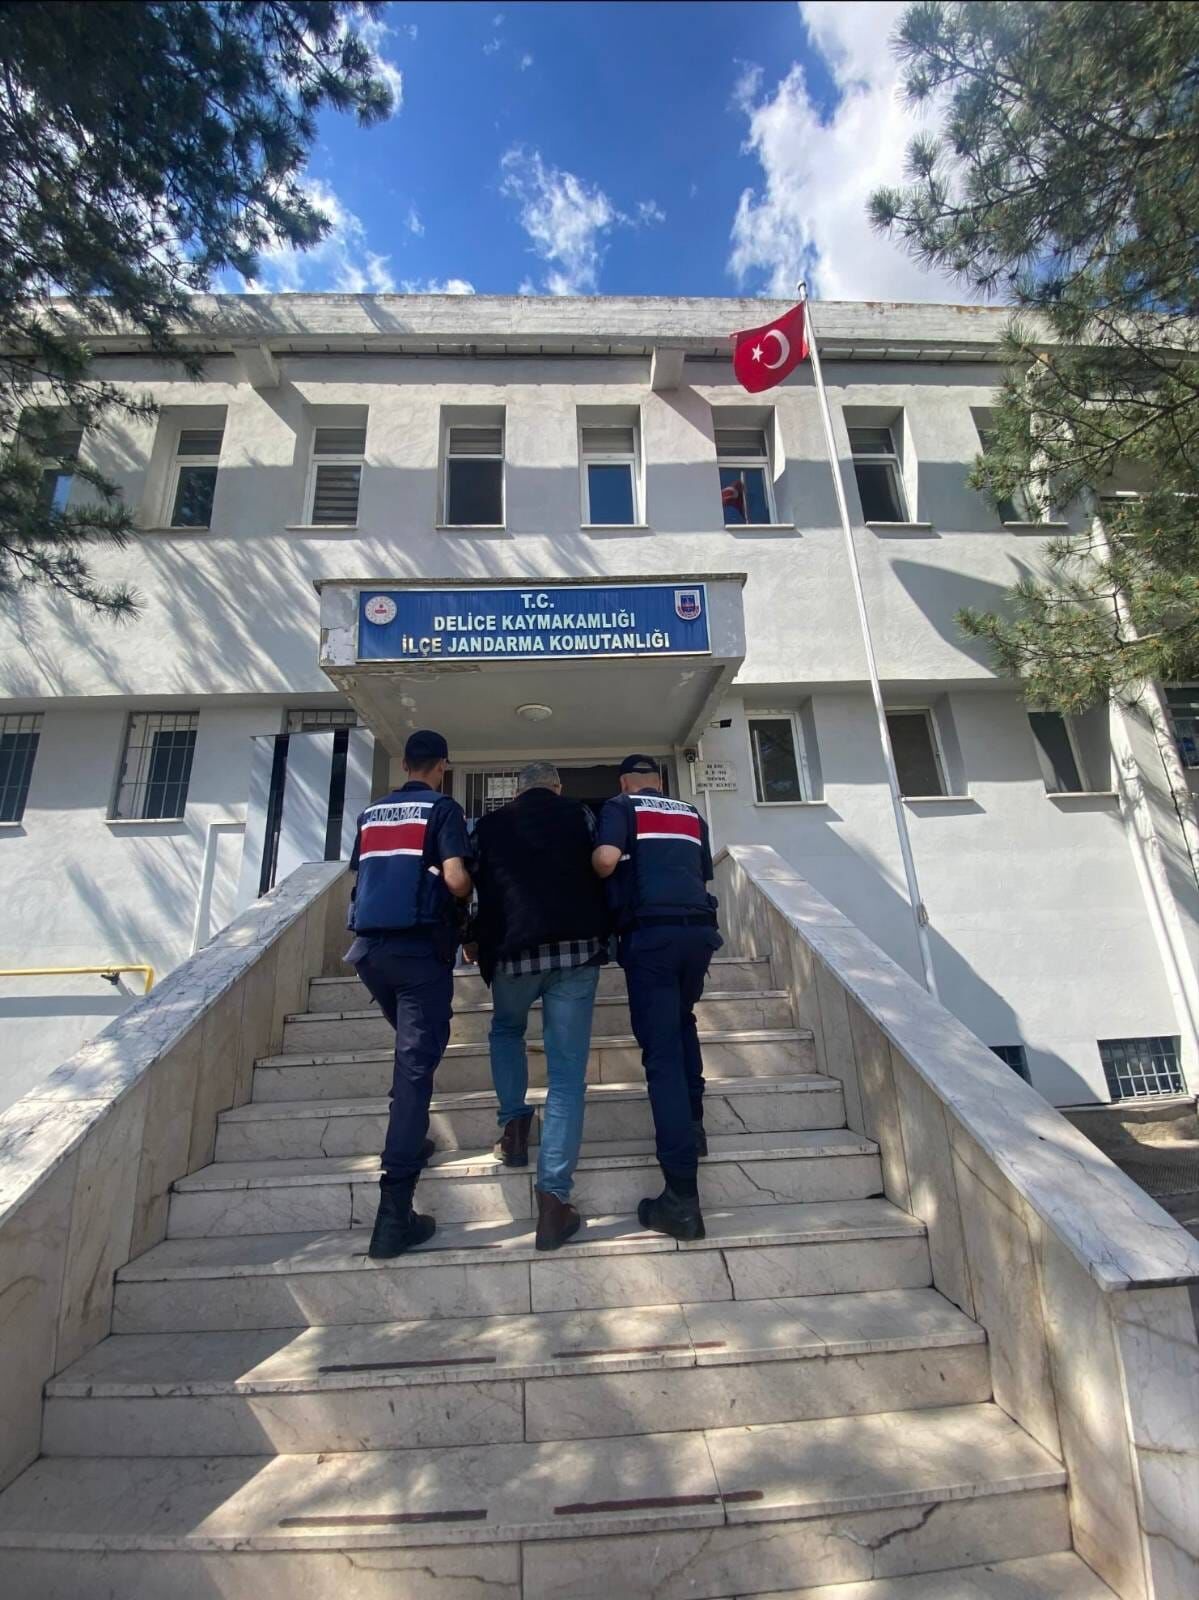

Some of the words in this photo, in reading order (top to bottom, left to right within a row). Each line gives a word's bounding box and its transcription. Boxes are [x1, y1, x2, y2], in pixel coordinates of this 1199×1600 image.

[520, 594, 554, 608] T.C.
[434, 612, 496, 631] DELİCE
[502, 609, 635, 630] KAYMAKAMLIĞI
[402, 634, 441, 656] İLÇE
[447, 635, 544, 653] JANDARMA
[549, 629, 671, 651] KOMUTANLIĞI
[368, 806, 421, 822] JANDARMA
